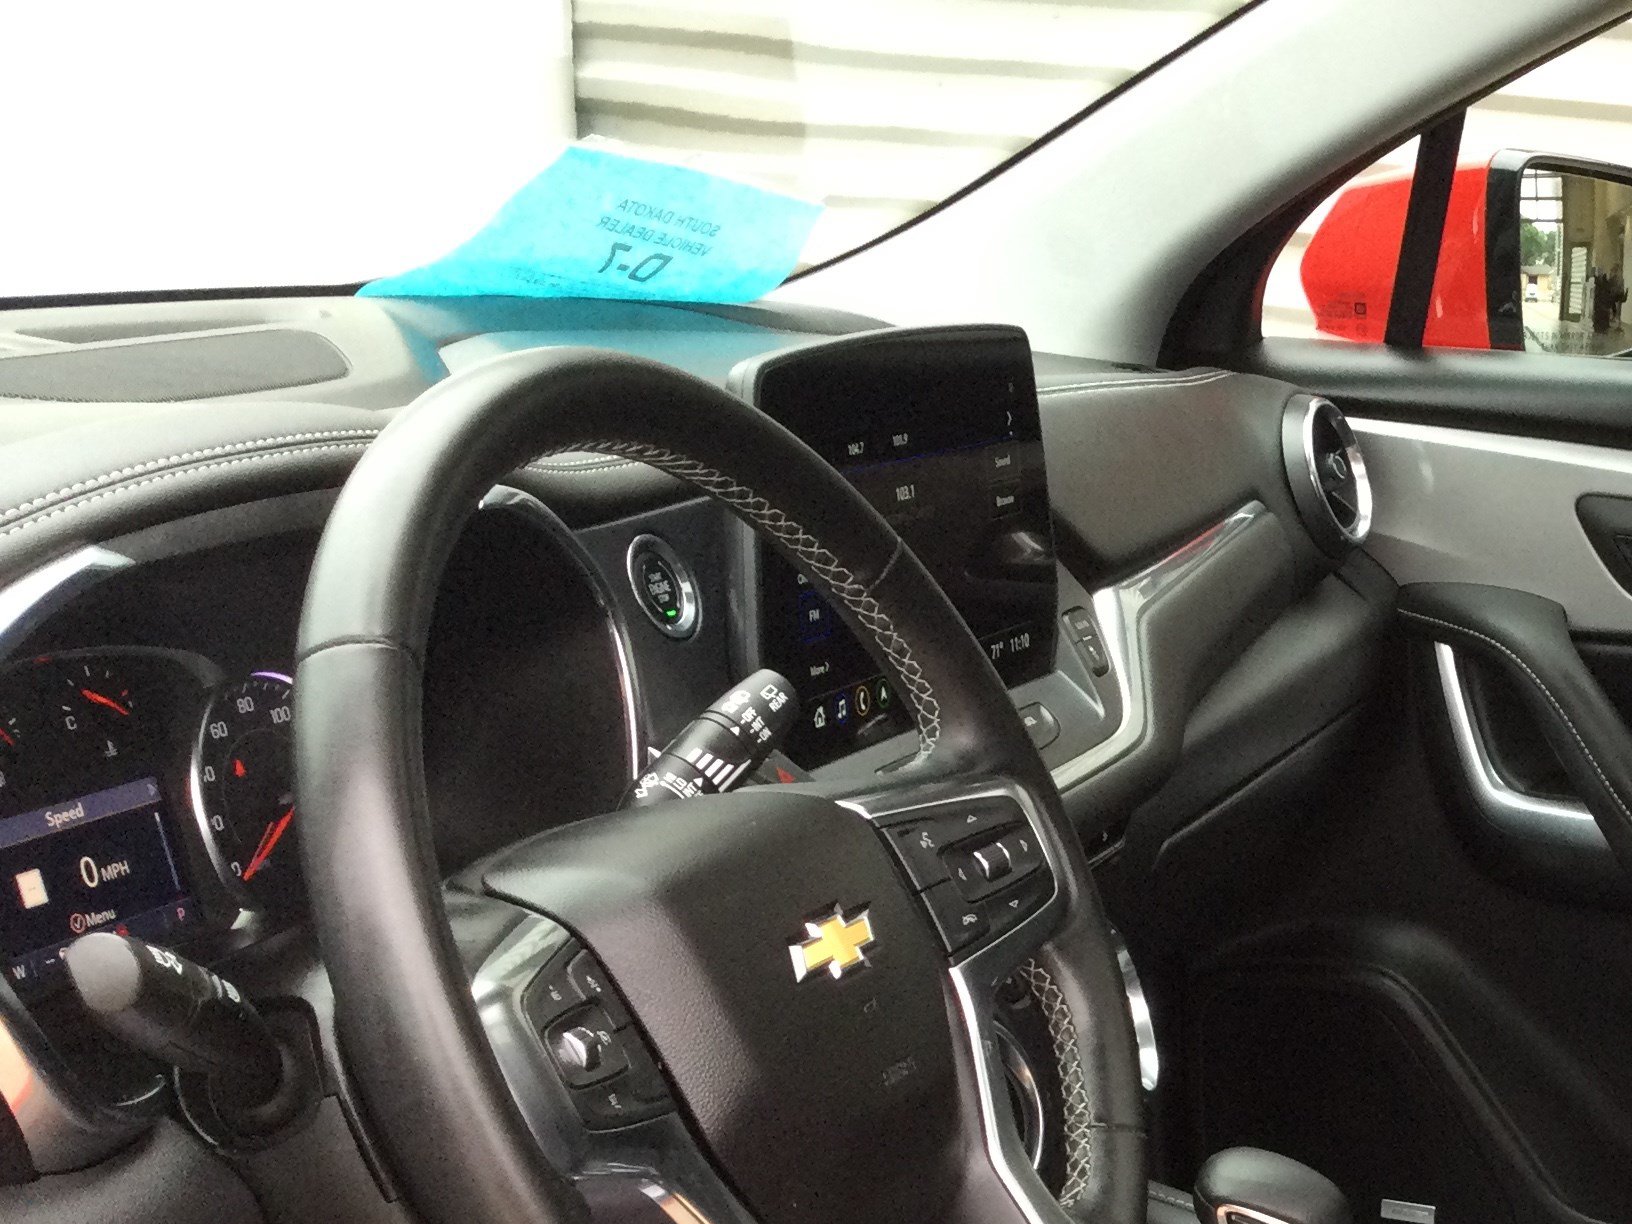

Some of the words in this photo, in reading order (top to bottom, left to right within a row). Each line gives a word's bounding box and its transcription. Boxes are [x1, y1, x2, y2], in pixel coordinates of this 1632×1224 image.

[1010, 632, 1030, 653] 11:10
[236, 696, 254, 714] 80
[769, 691, 788, 712] REAR
[269, 706, 291, 724] 100
[209, 721, 228, 739] 60
[45, 802, 85, 828] Speed
[79, 856, 98, 888] 0
[102, 860, 131, 882] MPH
[85, 909, 117, 927] Menu
